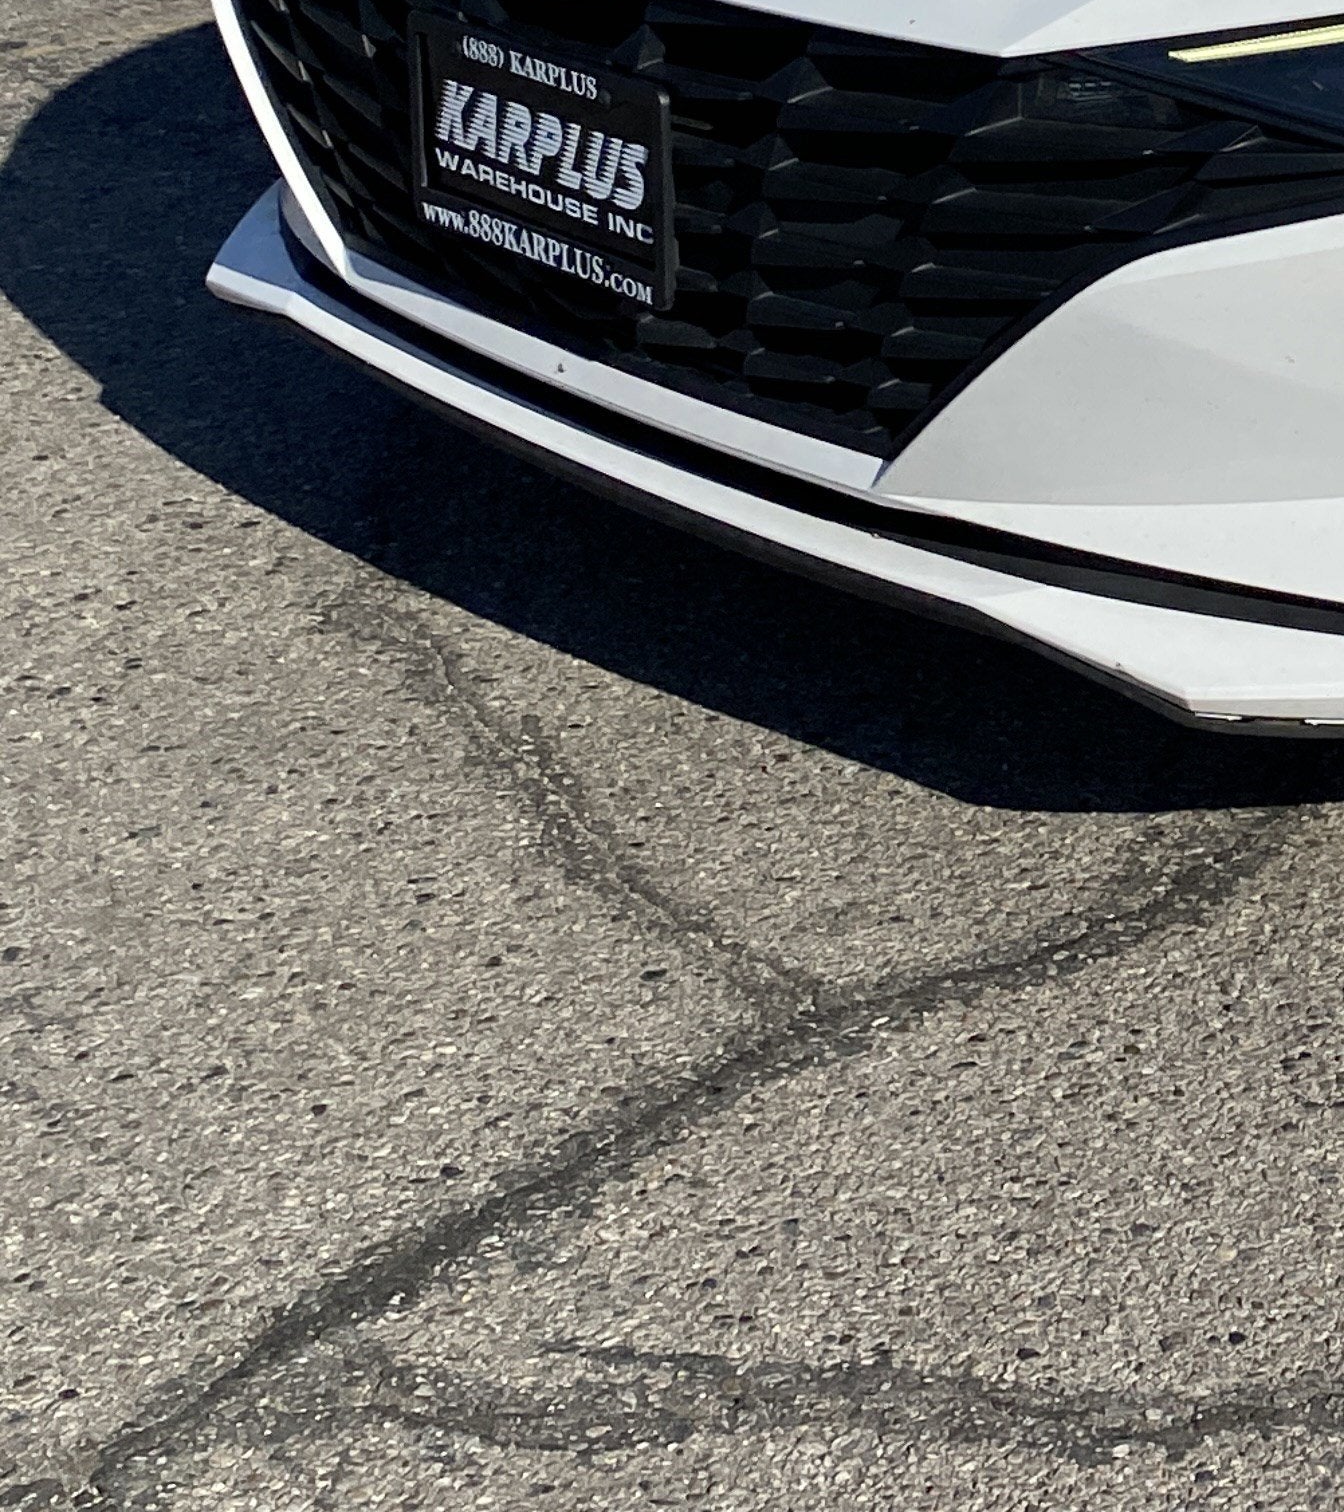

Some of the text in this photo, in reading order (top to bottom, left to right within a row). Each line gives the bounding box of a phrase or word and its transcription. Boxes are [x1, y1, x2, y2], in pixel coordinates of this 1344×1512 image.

[461, 35, 598, 100] (888) KARPLUS
[434, 78, 649, 210] KARPLUS
[435, 147, 654, 245] WAREHOUSE INC
